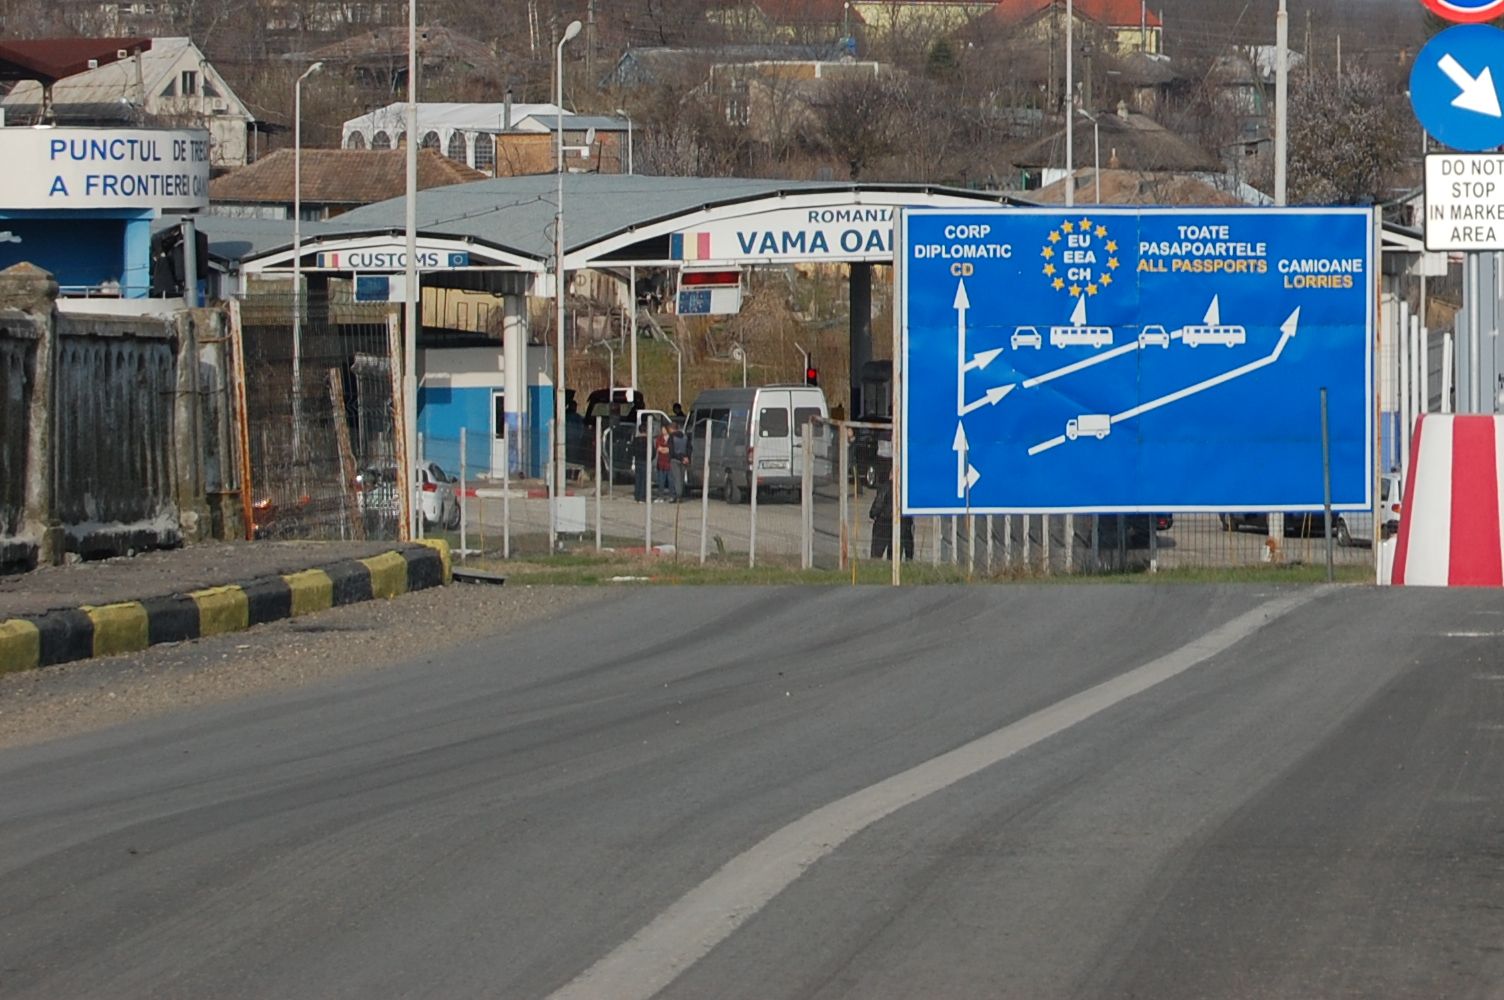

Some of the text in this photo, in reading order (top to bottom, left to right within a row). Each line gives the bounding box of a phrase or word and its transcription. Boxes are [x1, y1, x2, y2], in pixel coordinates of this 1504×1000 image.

[50, 139, 161, 162] PUNCTUL
[173, 139, 187, 162] DE
[1442, 159, 1504, 176] DO NOT
[49, 175, 69, 197] A
[85, 174, 190, 197] FRONTIEREI
[1452, 182, 1495, 198] STOP
[1430, 204, 1444, 220] IN
[944, 225, 991, 239] CORP
[1178, 226, 1230, 240] TOATE
[1450, 226, 1497, 242] AREA
[737, 230, 830, 254] VAMA
[1068, 235, 1090, 248] EU
[914, 244, 1012, 258] DIPLOMATIC
[1139, 242, 1267, 256] PASAPOARTELE
[348, 252, 439, 268] CUSTOMS
[1063, 251, 1096, 264] EEA
[950, 262, 975, 277] CD
[1137, 259, 1268, 273] ALL PASSPORTS
[1277, 259, 1363, 273] CAMIOANE
[1067, 268, 1091, 281] CH
[1284, 275, 1353, 289] LORRIES
